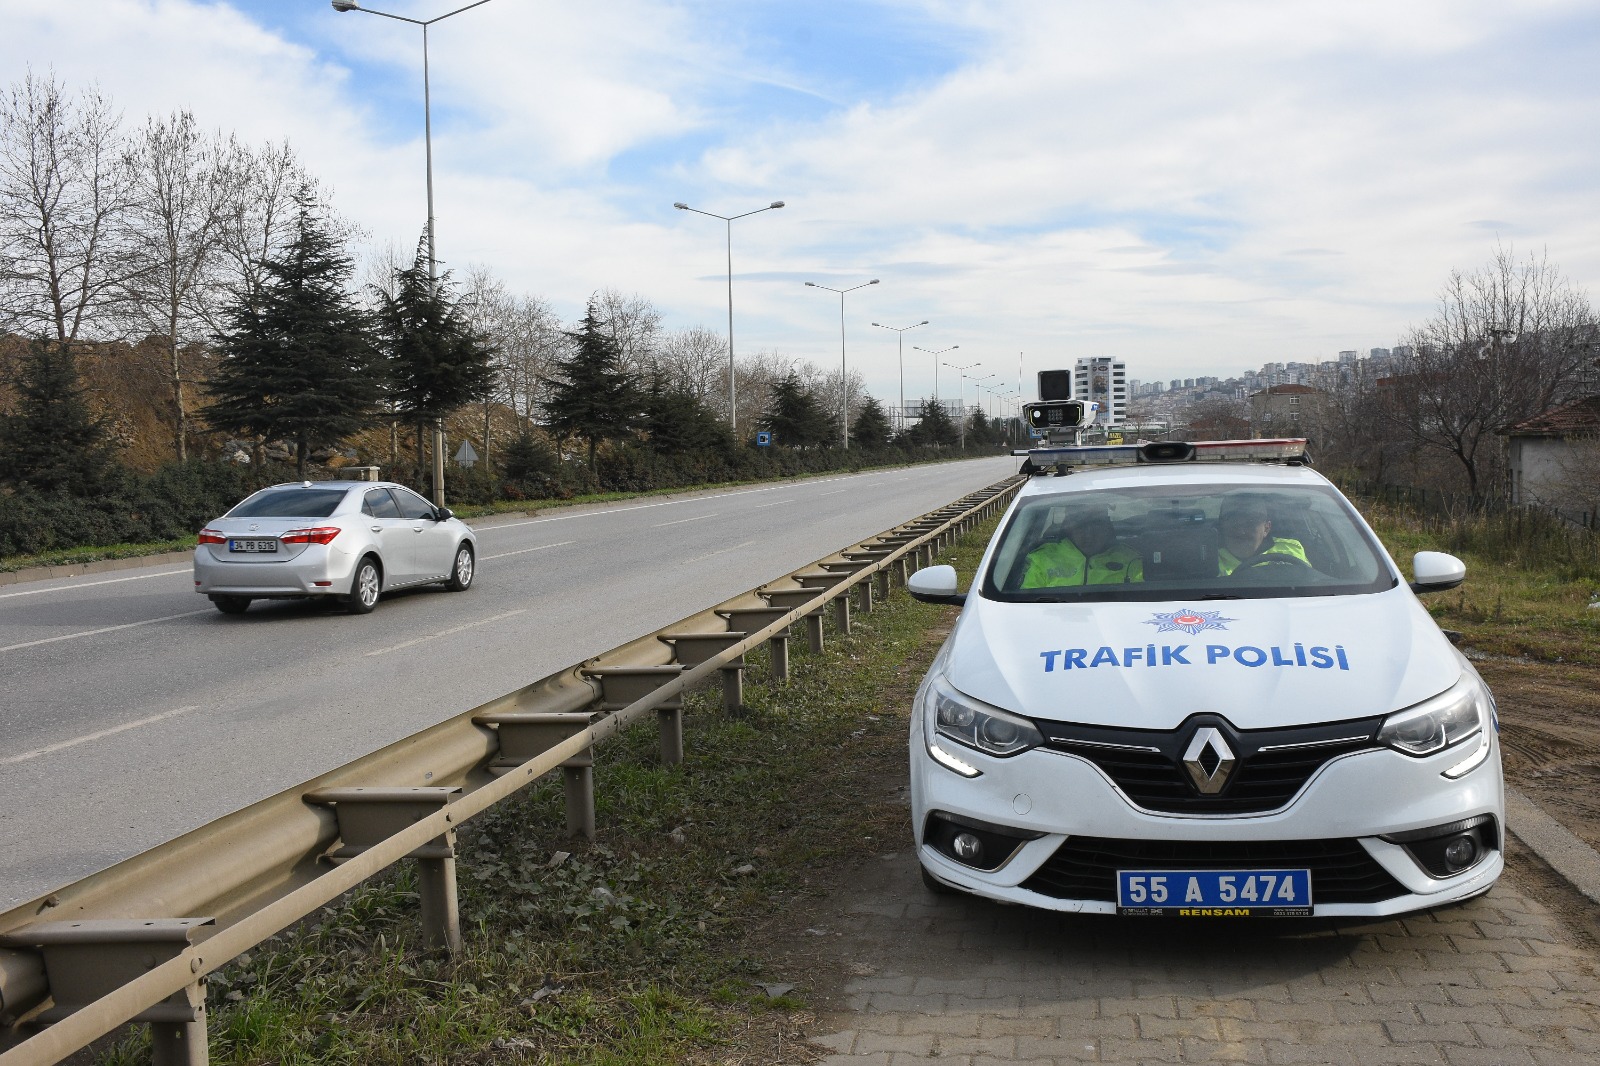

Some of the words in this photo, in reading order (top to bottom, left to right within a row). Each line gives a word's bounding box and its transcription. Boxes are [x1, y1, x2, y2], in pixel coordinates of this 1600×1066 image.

[234, 541, 243, 550] 34
[246, 541, 255, 550] PB
[1039, 643, 1192, 673] TRAFİK
[1205, 642, 1350, 671] POLİSİ
[1129, 876, 1168, 903] 55
[1184, 876, 1204, 903] A
[1218, 875, 1296, 903] 5474
[1179, 909, 1250, 917] RENSAM
